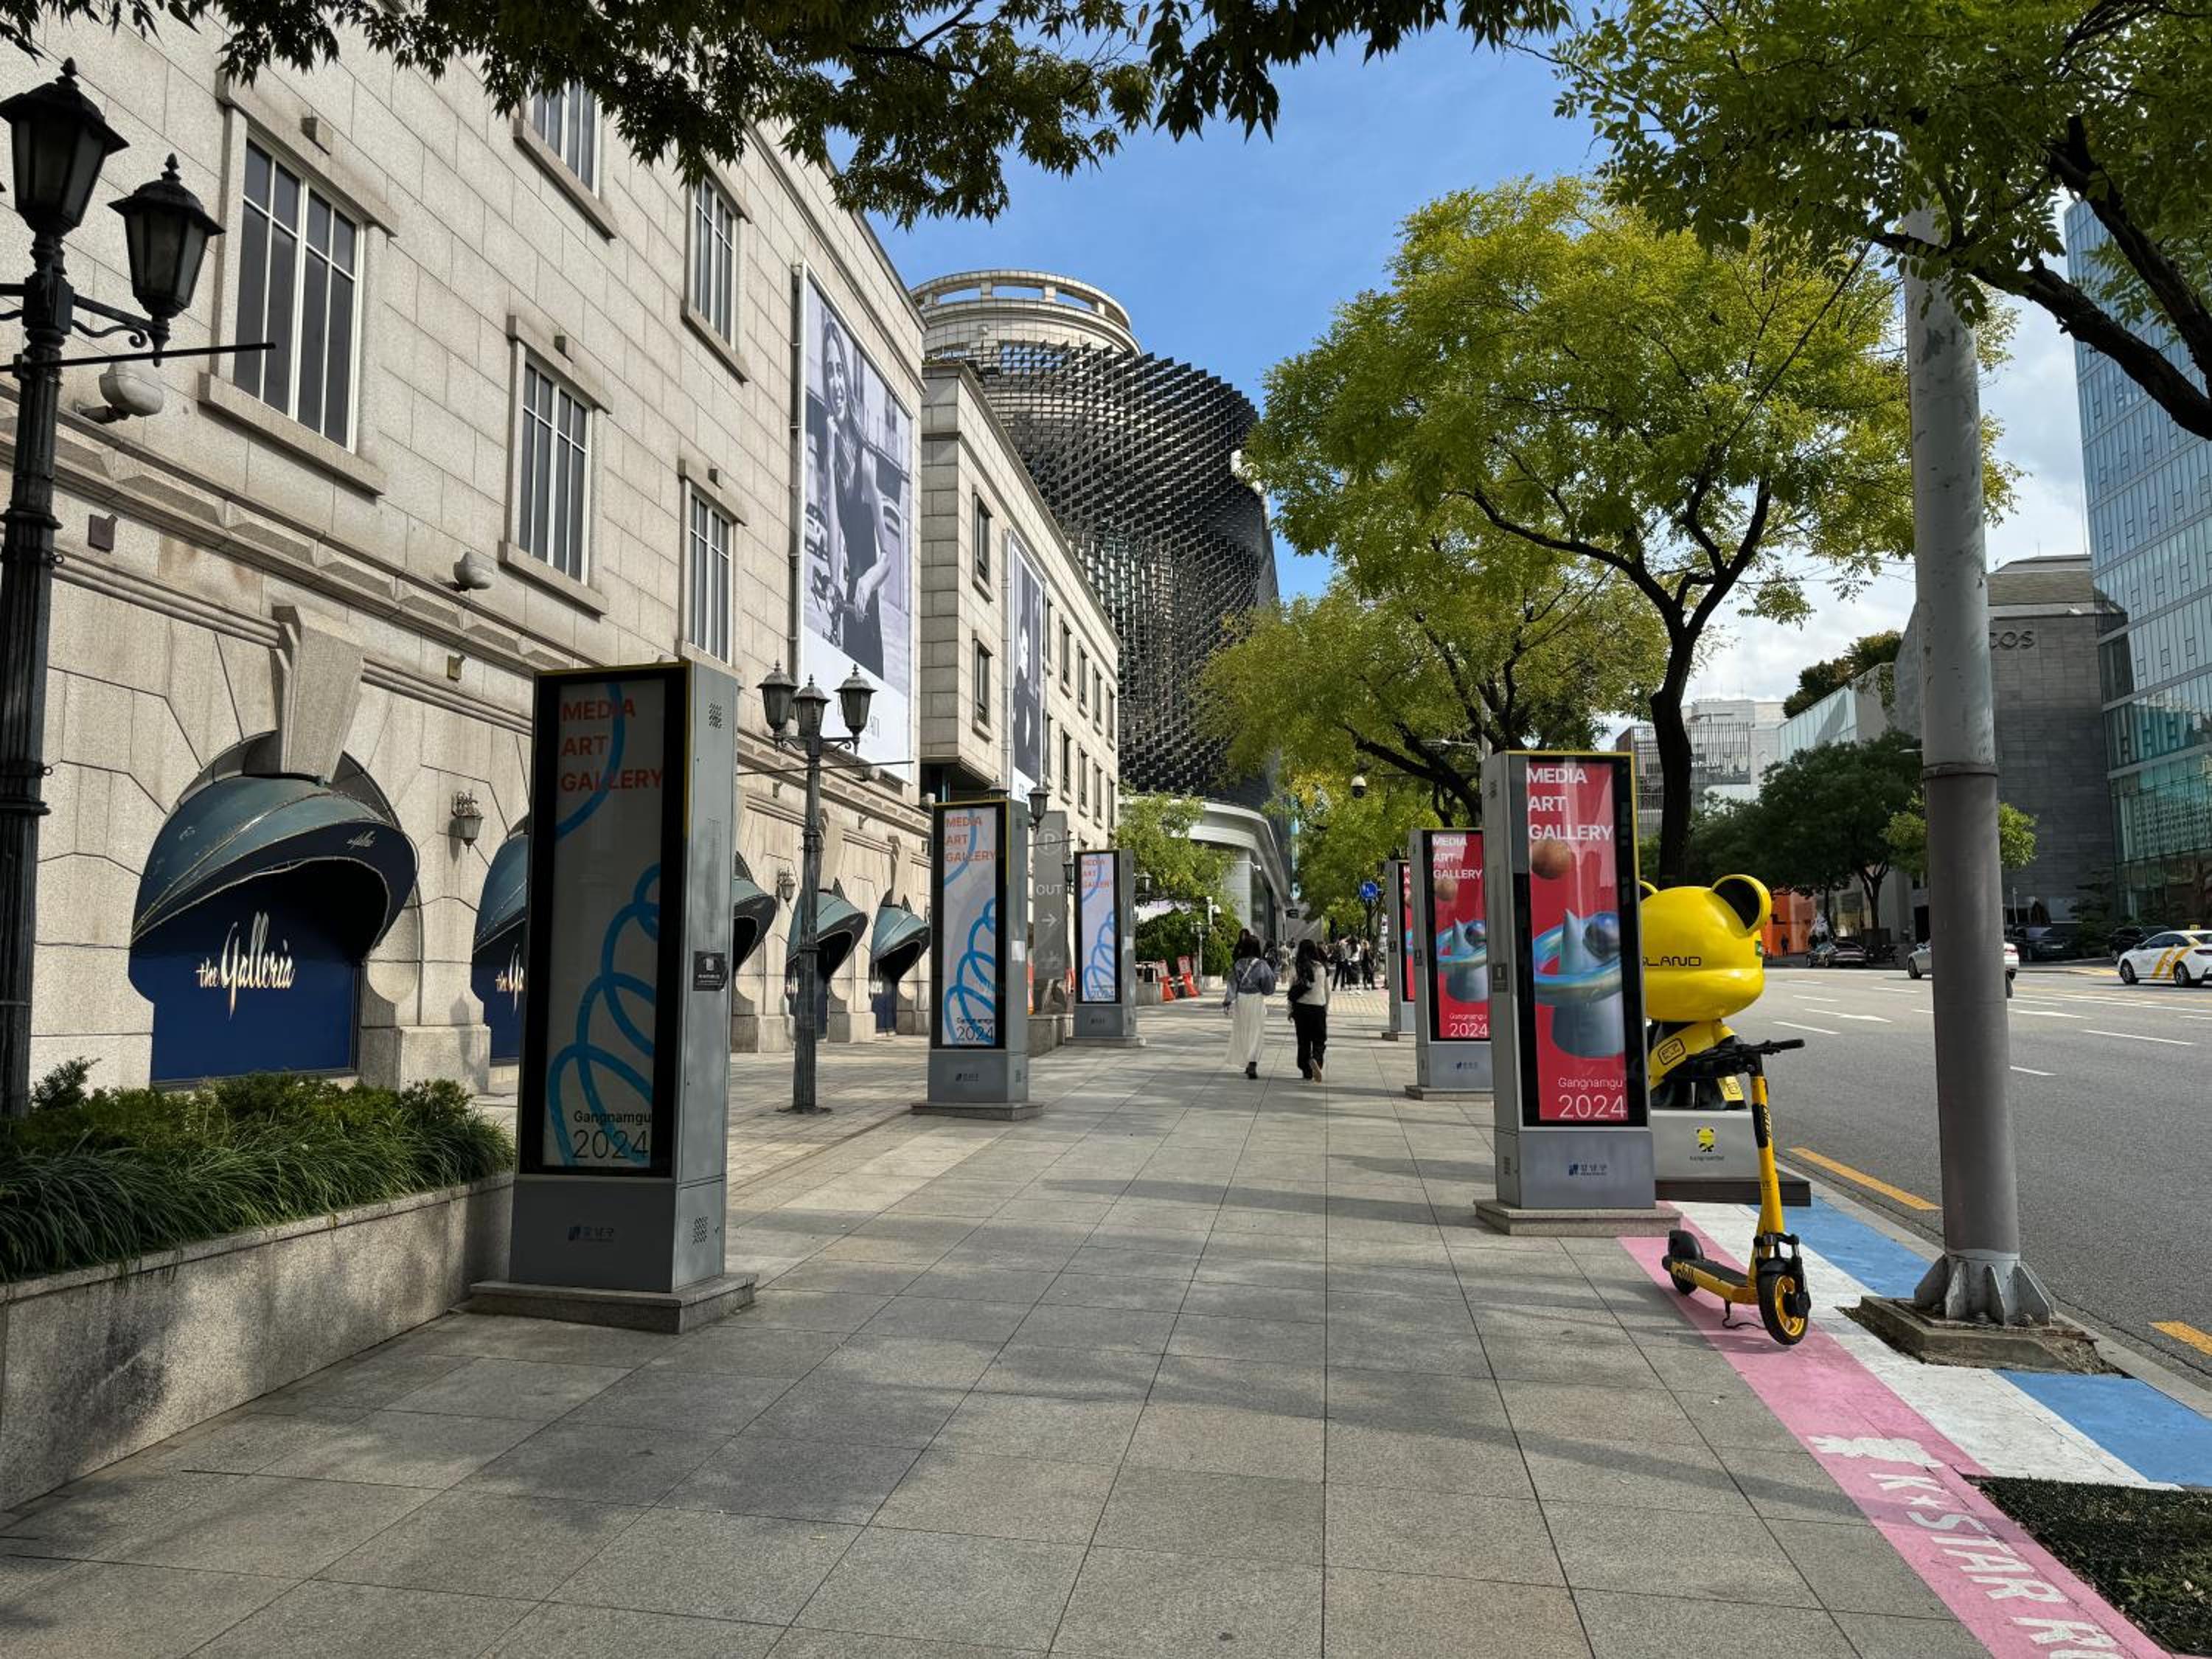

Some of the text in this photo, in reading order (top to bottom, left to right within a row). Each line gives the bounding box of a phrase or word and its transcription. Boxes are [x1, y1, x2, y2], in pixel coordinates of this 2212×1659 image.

[560, 736, 608, 757] ART
[1526, 768, 1588, 784] MEDIA
[1527, 796, 1567, 812] ART
[945, 816, 982, 827] MEDIA
[945, 834, 968, 845] ART
[1528, 824, 1614, 841] GALLERY
[1432, 836, 1467, 846] MEDIA
[1433, 853, 1455, 862] ART
[1433, 869, 1482, 880] GALLERY
[1035, 884, 1063, 895] OUT
[195, 911, 295, 1022] the Galleria
[956, 1026, 994, 1041] 2024
[1450, 1022, 1488, 1037] 2024
[1558, 1077, 1623, 1091] Gangnamgu
[1558, 1094, 1627, 1119] 2024
[574, 1110, 651, 1125] Gangnamgu
[573, 1129, 649, 1158] 2024
